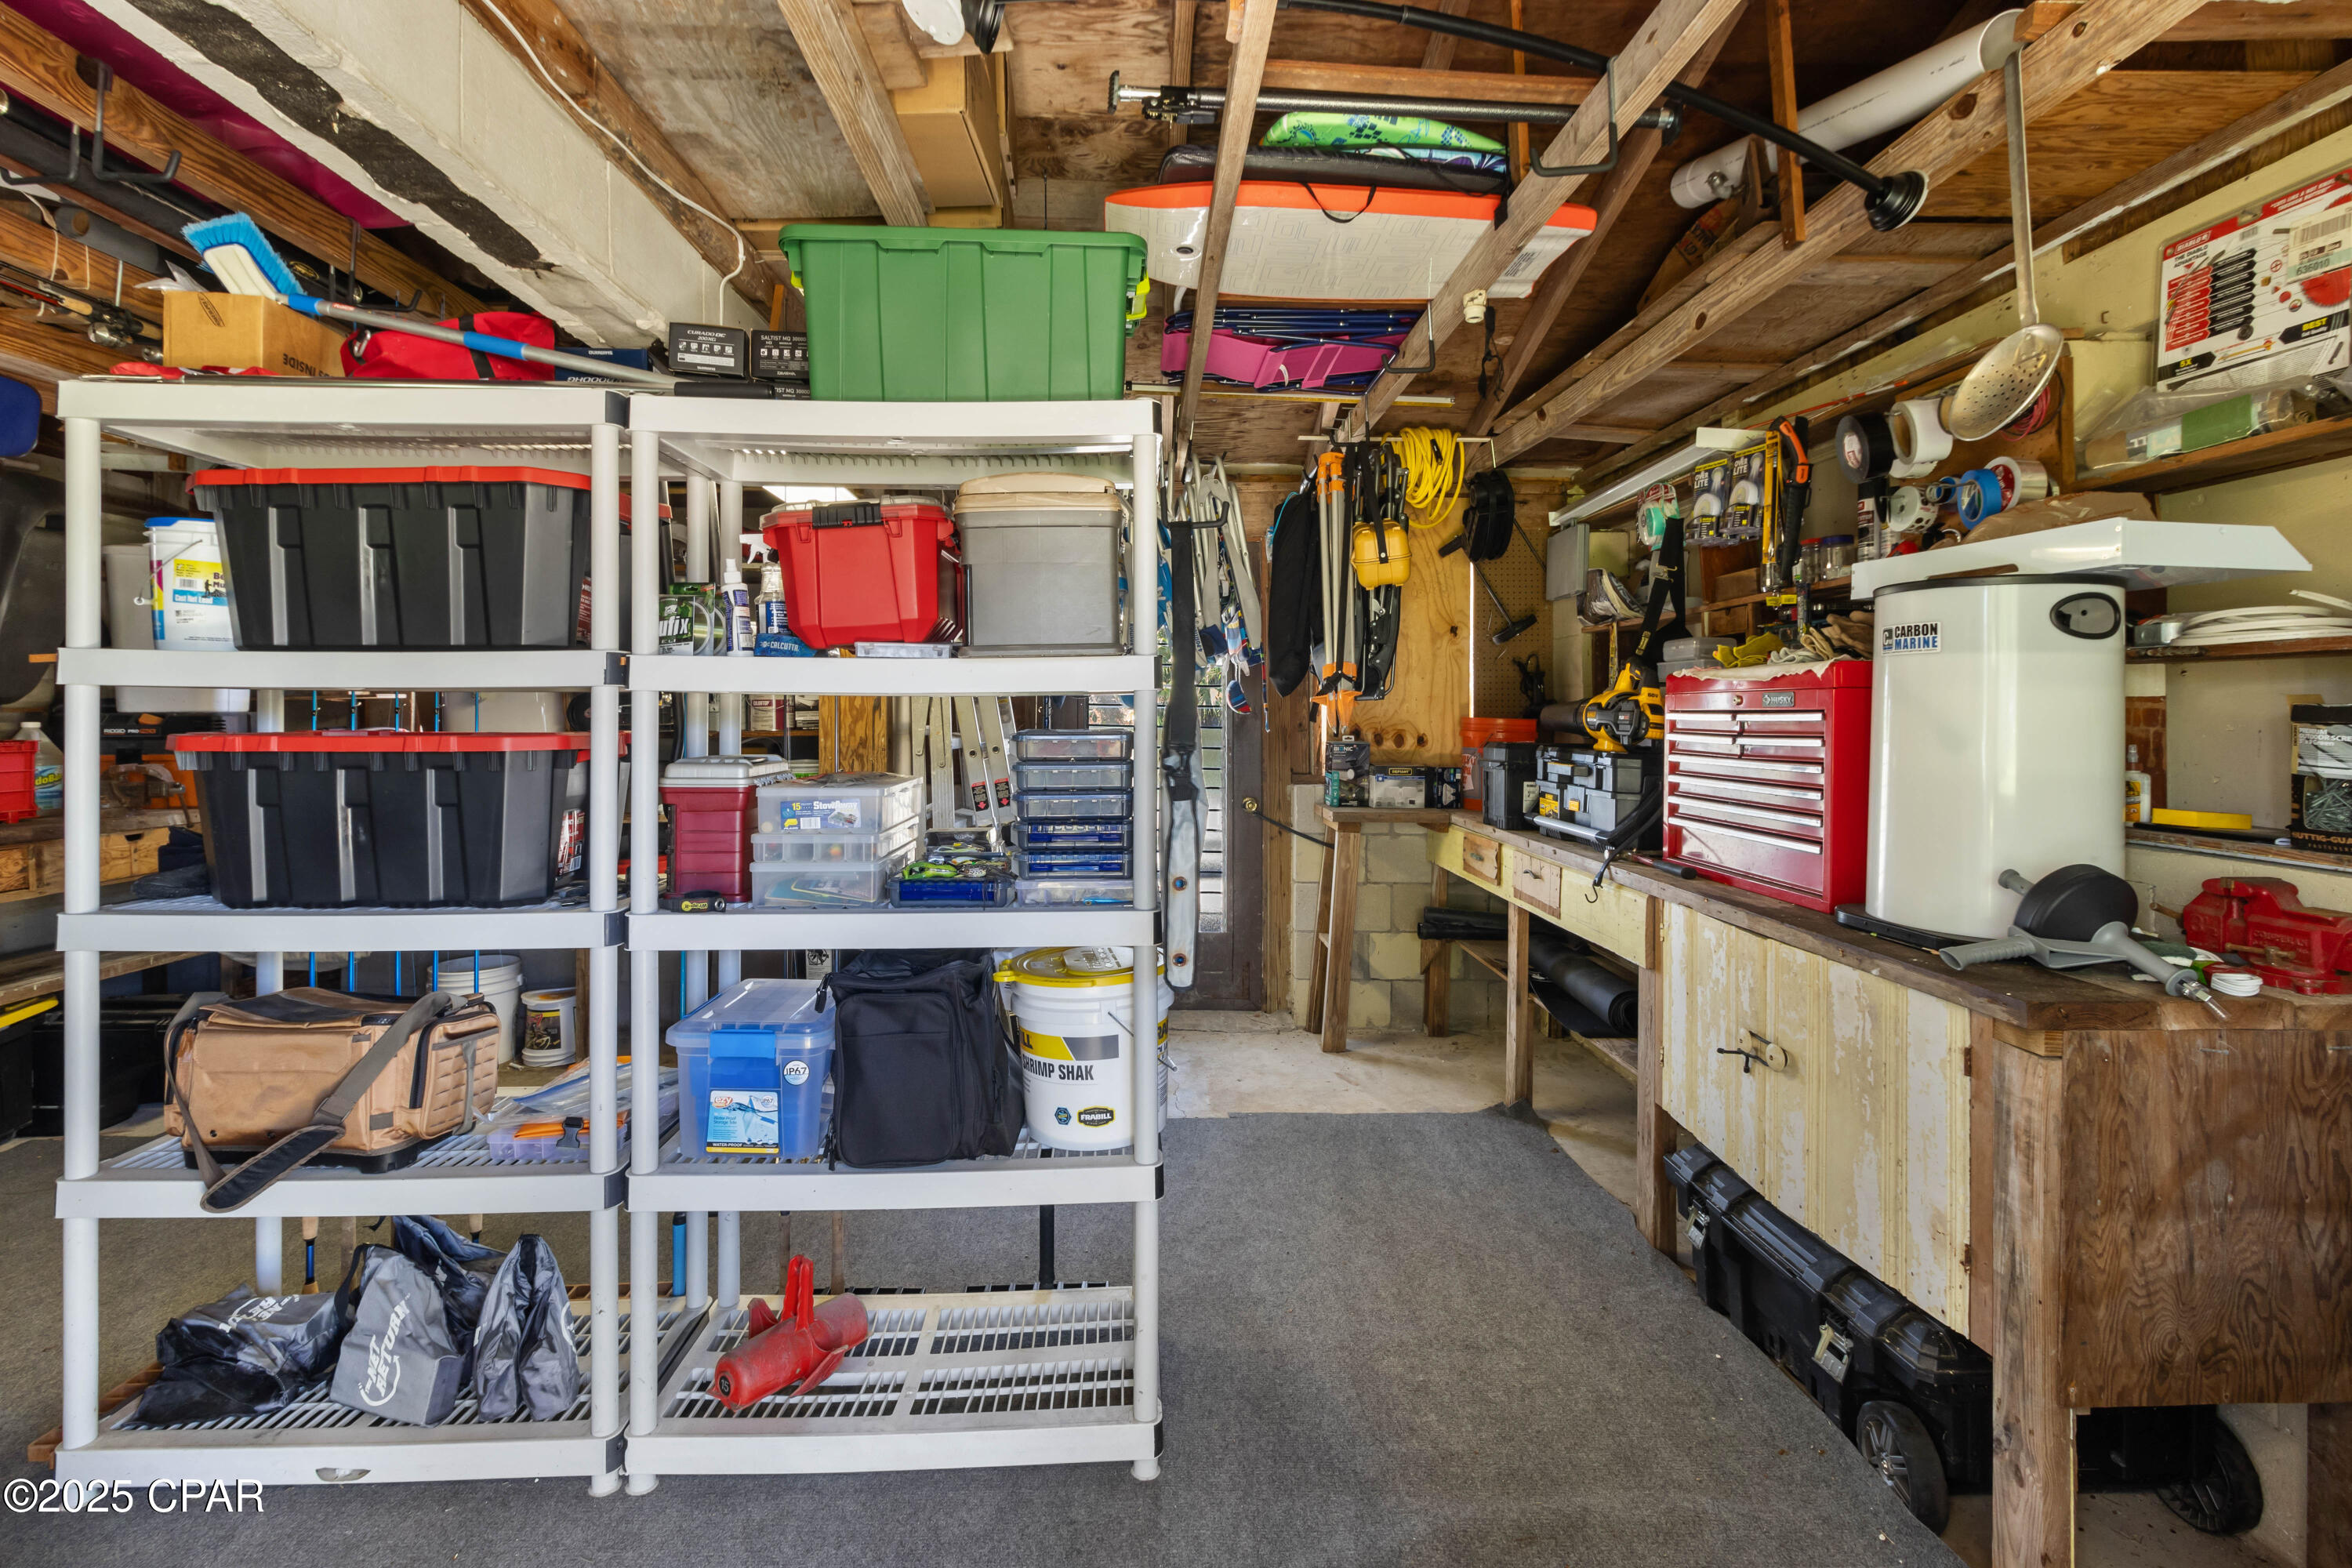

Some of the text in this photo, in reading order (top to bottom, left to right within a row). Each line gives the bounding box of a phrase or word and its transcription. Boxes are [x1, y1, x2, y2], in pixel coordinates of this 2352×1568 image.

[2176, 235, 2201, 251] DIABLO
[2186, 245, 2208, 256] DIABLO
[2174, 251, 2208, 268] ADVANTAGE
[2296, 259, 2330, 275] 636010
[2302, 317, 2328, 331] BEST
[282, 353, 316, 376] INSIDE
[2180, 358, 2192, 368] 5X
[1734, 456, 1748, 467] OVER
[1695, 470, 1709, 481] OVER
[1733, 466, 1748, 476] LITE
[1694, 479, 1708, 489] LITE
[659, 615, 689, 637] ufix
[1894, 622, 1938, 638] CARBON
[1894, 636, 1938, 651] MARINE
[792, 802, 801, 811] 15
[786, 1067, 807, 1076] IP67
[1022, 1054, 1055, 1078] SHRIMP
[1058, 1064, 1094, 1080] SHAK
[714, 1096, 733, 1106] ezy
[1080, 1112, 1112, 1121] FRABILL
[376, 1300, 410, 1398] RETURN
[367, 1334, 380, 1385] NET
[720, 1379, 729, 1392] 15
